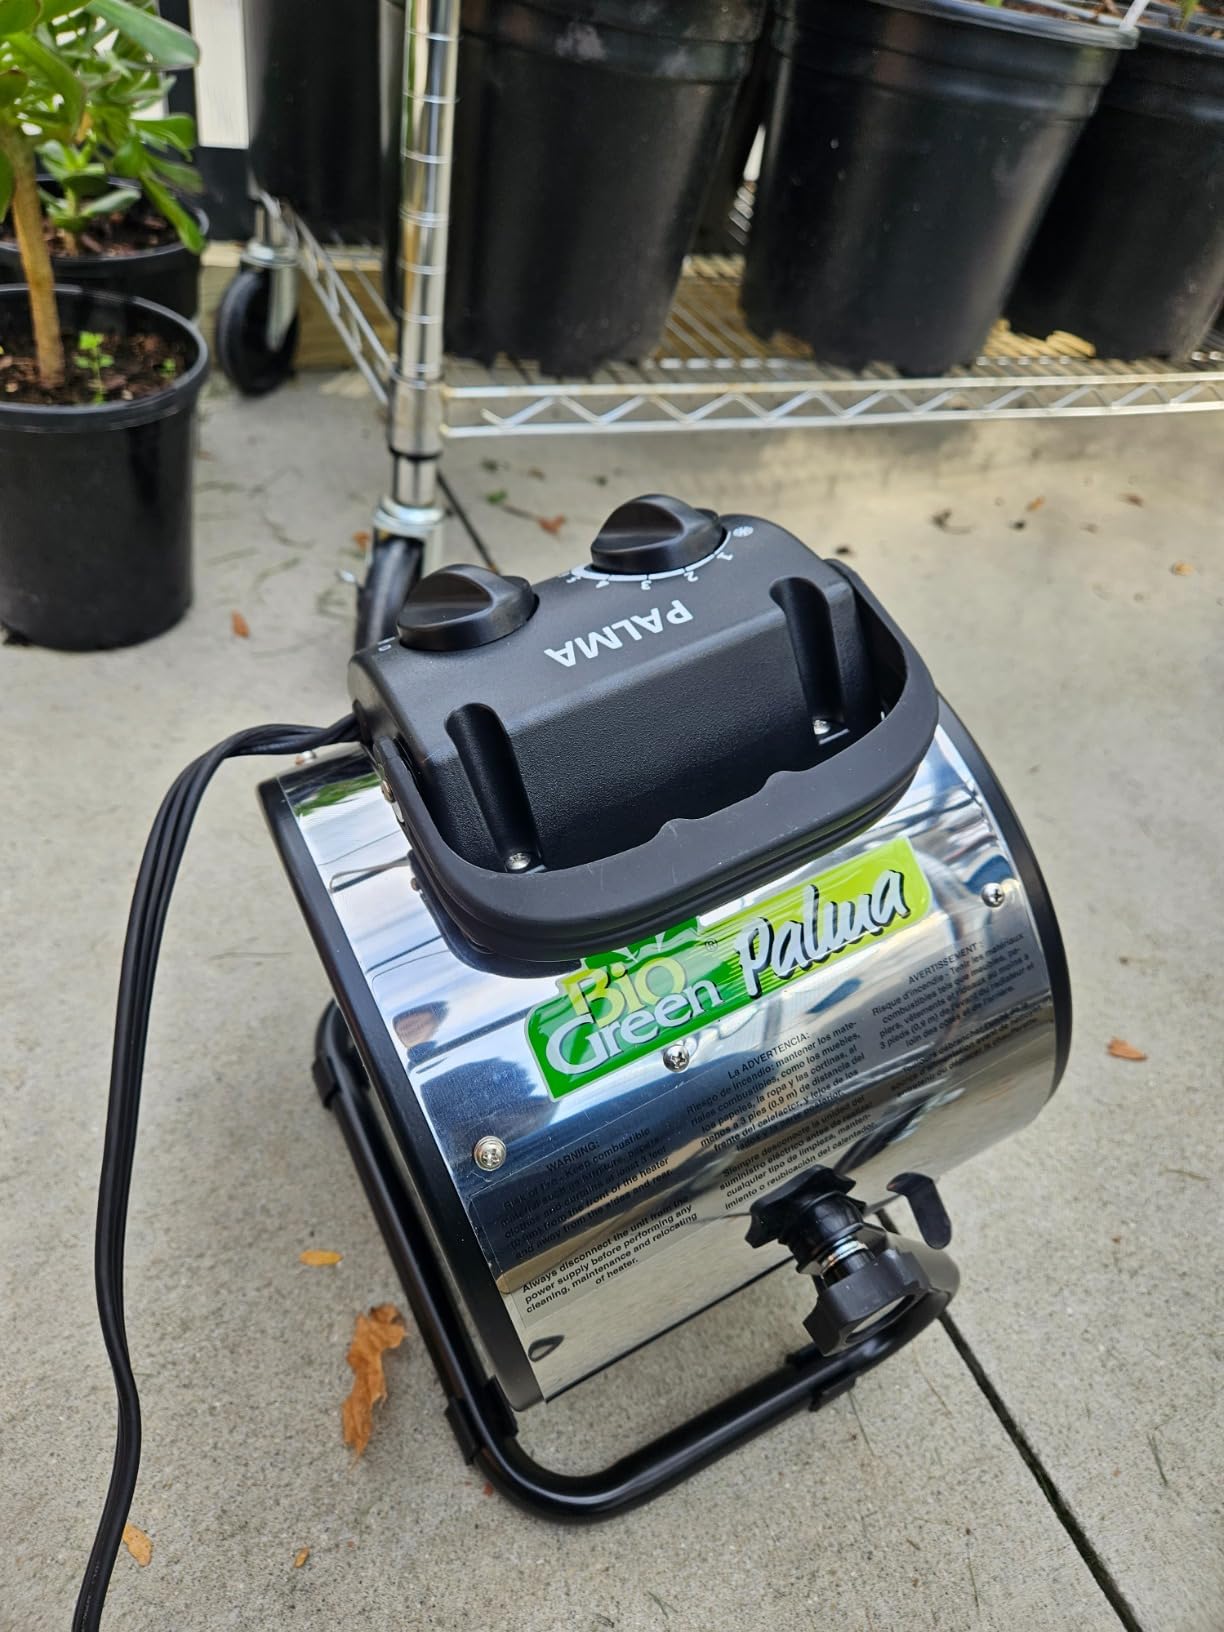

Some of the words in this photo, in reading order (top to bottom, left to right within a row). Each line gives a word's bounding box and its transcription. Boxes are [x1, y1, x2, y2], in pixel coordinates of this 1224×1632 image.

[641, 580, 652, 590] 3
[543, 599, 694, 668] PALMA
[733, 869, 912, 1000] Palma
[546, 979, 724, 1076] Green
[727, 1068, 739, 1078] La
[739, 1031, 810, 1071] ADVERTENCIA:
[774, 1041, 816, 1067] mantener
[817, 1033, 831, 1045] los
[831, 1020, 856, 1036] mate-
[700, 1126, 731, 1146] menos
[739, 1116, 746, 1124] 3
[746, 1105, 767, 1121] pies
[767, 1096, 785, 1110] (0.9
[784, 1088, 798, 1100] m)
[798, 1082, 810, 1092] de
[810, 1060, 850, 1085] distancia
[850, 1052, 865, 1064] del
[716, 1074, 779, 1110] combustibles,
[780, 1060, 805, 1077] como
[806, 1052, 820, 1063] los
[820, 1030, 860, 1055] muebles,
[717, 1100, 755, 1124] papeles,
[756, 1094, 764, 1102] la
[765, 1083, 787, 1098] ropa
[788, 1079, 795, 1087] y
[795, 1071, 808, 1081] las
[809, 1050, 847, 1074] cortinas,
[847, 1045, 856, 1053] al
[713, 1133, 741, 1151] frente
[741, 1124, 755, 1135] del
[803, 1096, 810, 1104] y
[832, 1076, 843, 1085] de
[844, 1067, 858, 1078] los
[546, 1138, 600, 1172] WARNING:
[589, 1125, 651, 1163] combustible
[621, 1172, 638, 1186] the
[638, 1155, 669, 1177] heater
[718, 1161, 766, 1189] suministro
[766, 1139, 804, 1163] eléctrico
[722, 1152, 760, 1177] Siempre
[725, 1170, 767, 1197] cualquier
[768, 1160, 785, 1173] tipo
[786, 1153, 798, 1163] de
[798, 1131, 836, 1156] limpieza,
[836, 1113, 871, 1134] manten-
[765, 1154, 817, 1186] reubicación
[816, 1146, 831, 1157] del
[521, 1269, 557, 1292] Always
[558, 1238, 612, 1271] disconnect
[613, 1228, 628, 1240] the
[629, 1216, 649, 1231] unit
[649, 1204, 672, 1220] from
[524, 1281, 557, 1304] power
[556, 1262, 590, 1285] supply
[590, 1243, 622, 1264] before
[622, 1214, 674, 1247] performing
[674, 1204, 694, 1218] any
[525, 1284, 571, 1314] cleaning,
[570, 1249, 632, 1287] maintenance
[631, 1238, 650, 1252] and
[651, 1211, 698, 1241] relocating
[596, 1275, 605, 1285] of
[607, 1257, 639, 1279] heater.
